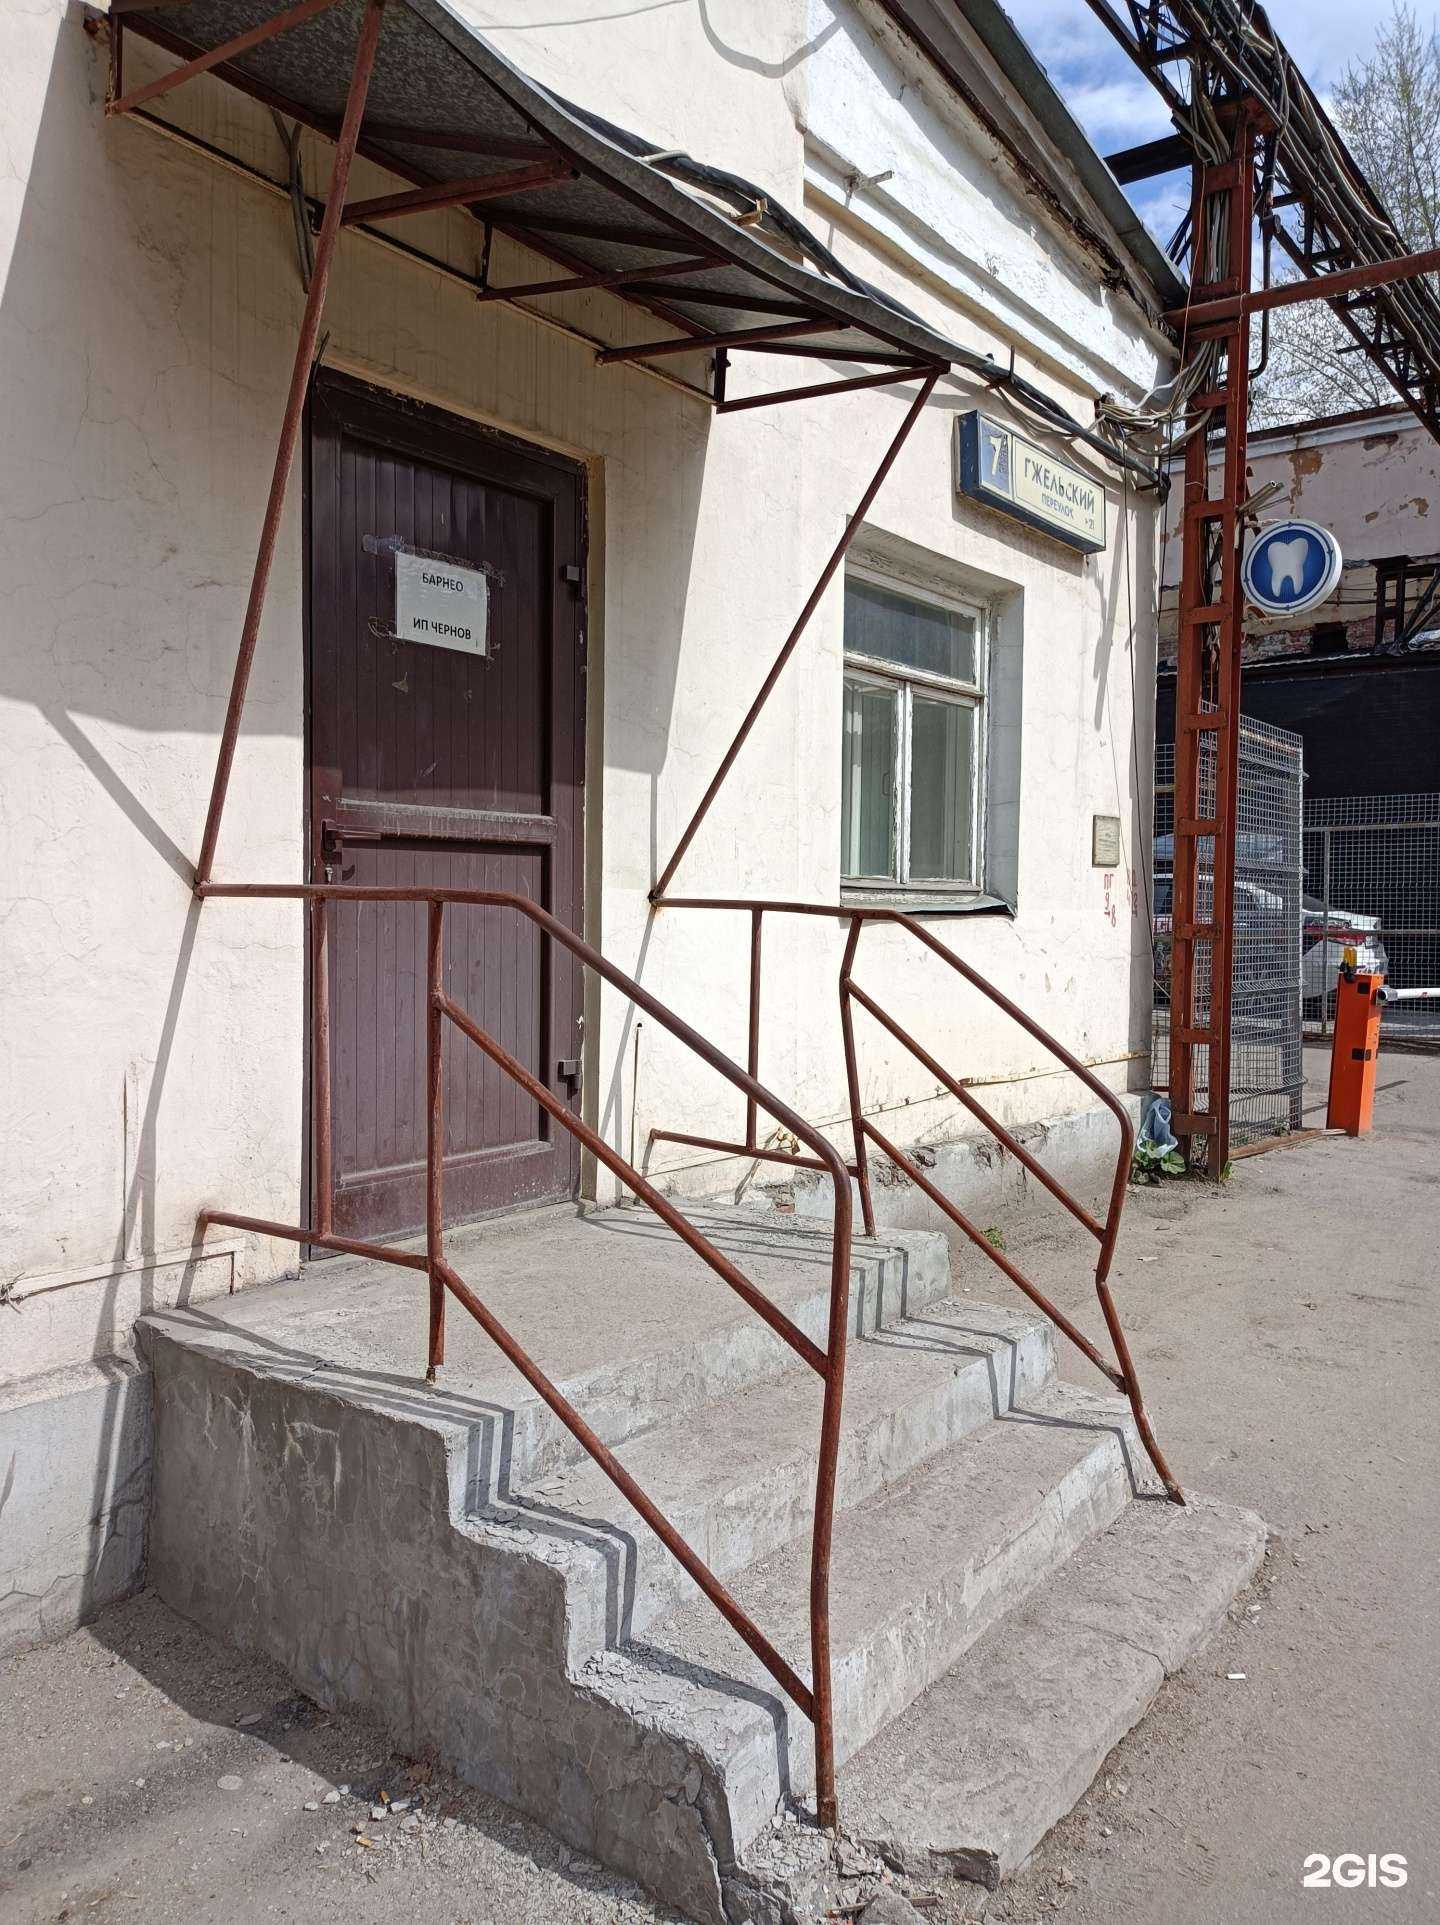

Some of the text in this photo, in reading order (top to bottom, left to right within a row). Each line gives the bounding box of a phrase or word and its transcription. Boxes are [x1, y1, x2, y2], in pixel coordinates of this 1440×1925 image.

[1024, 457, 1095, 514] ГЖЕЛЬСКИЙ
[1041, 493, 1074, 519] ПЕРЕУЛОК
[422, 572, 464, 592] БАРНЕО
[413, 617, 471, 640] ИП ЧЕРНОВ
